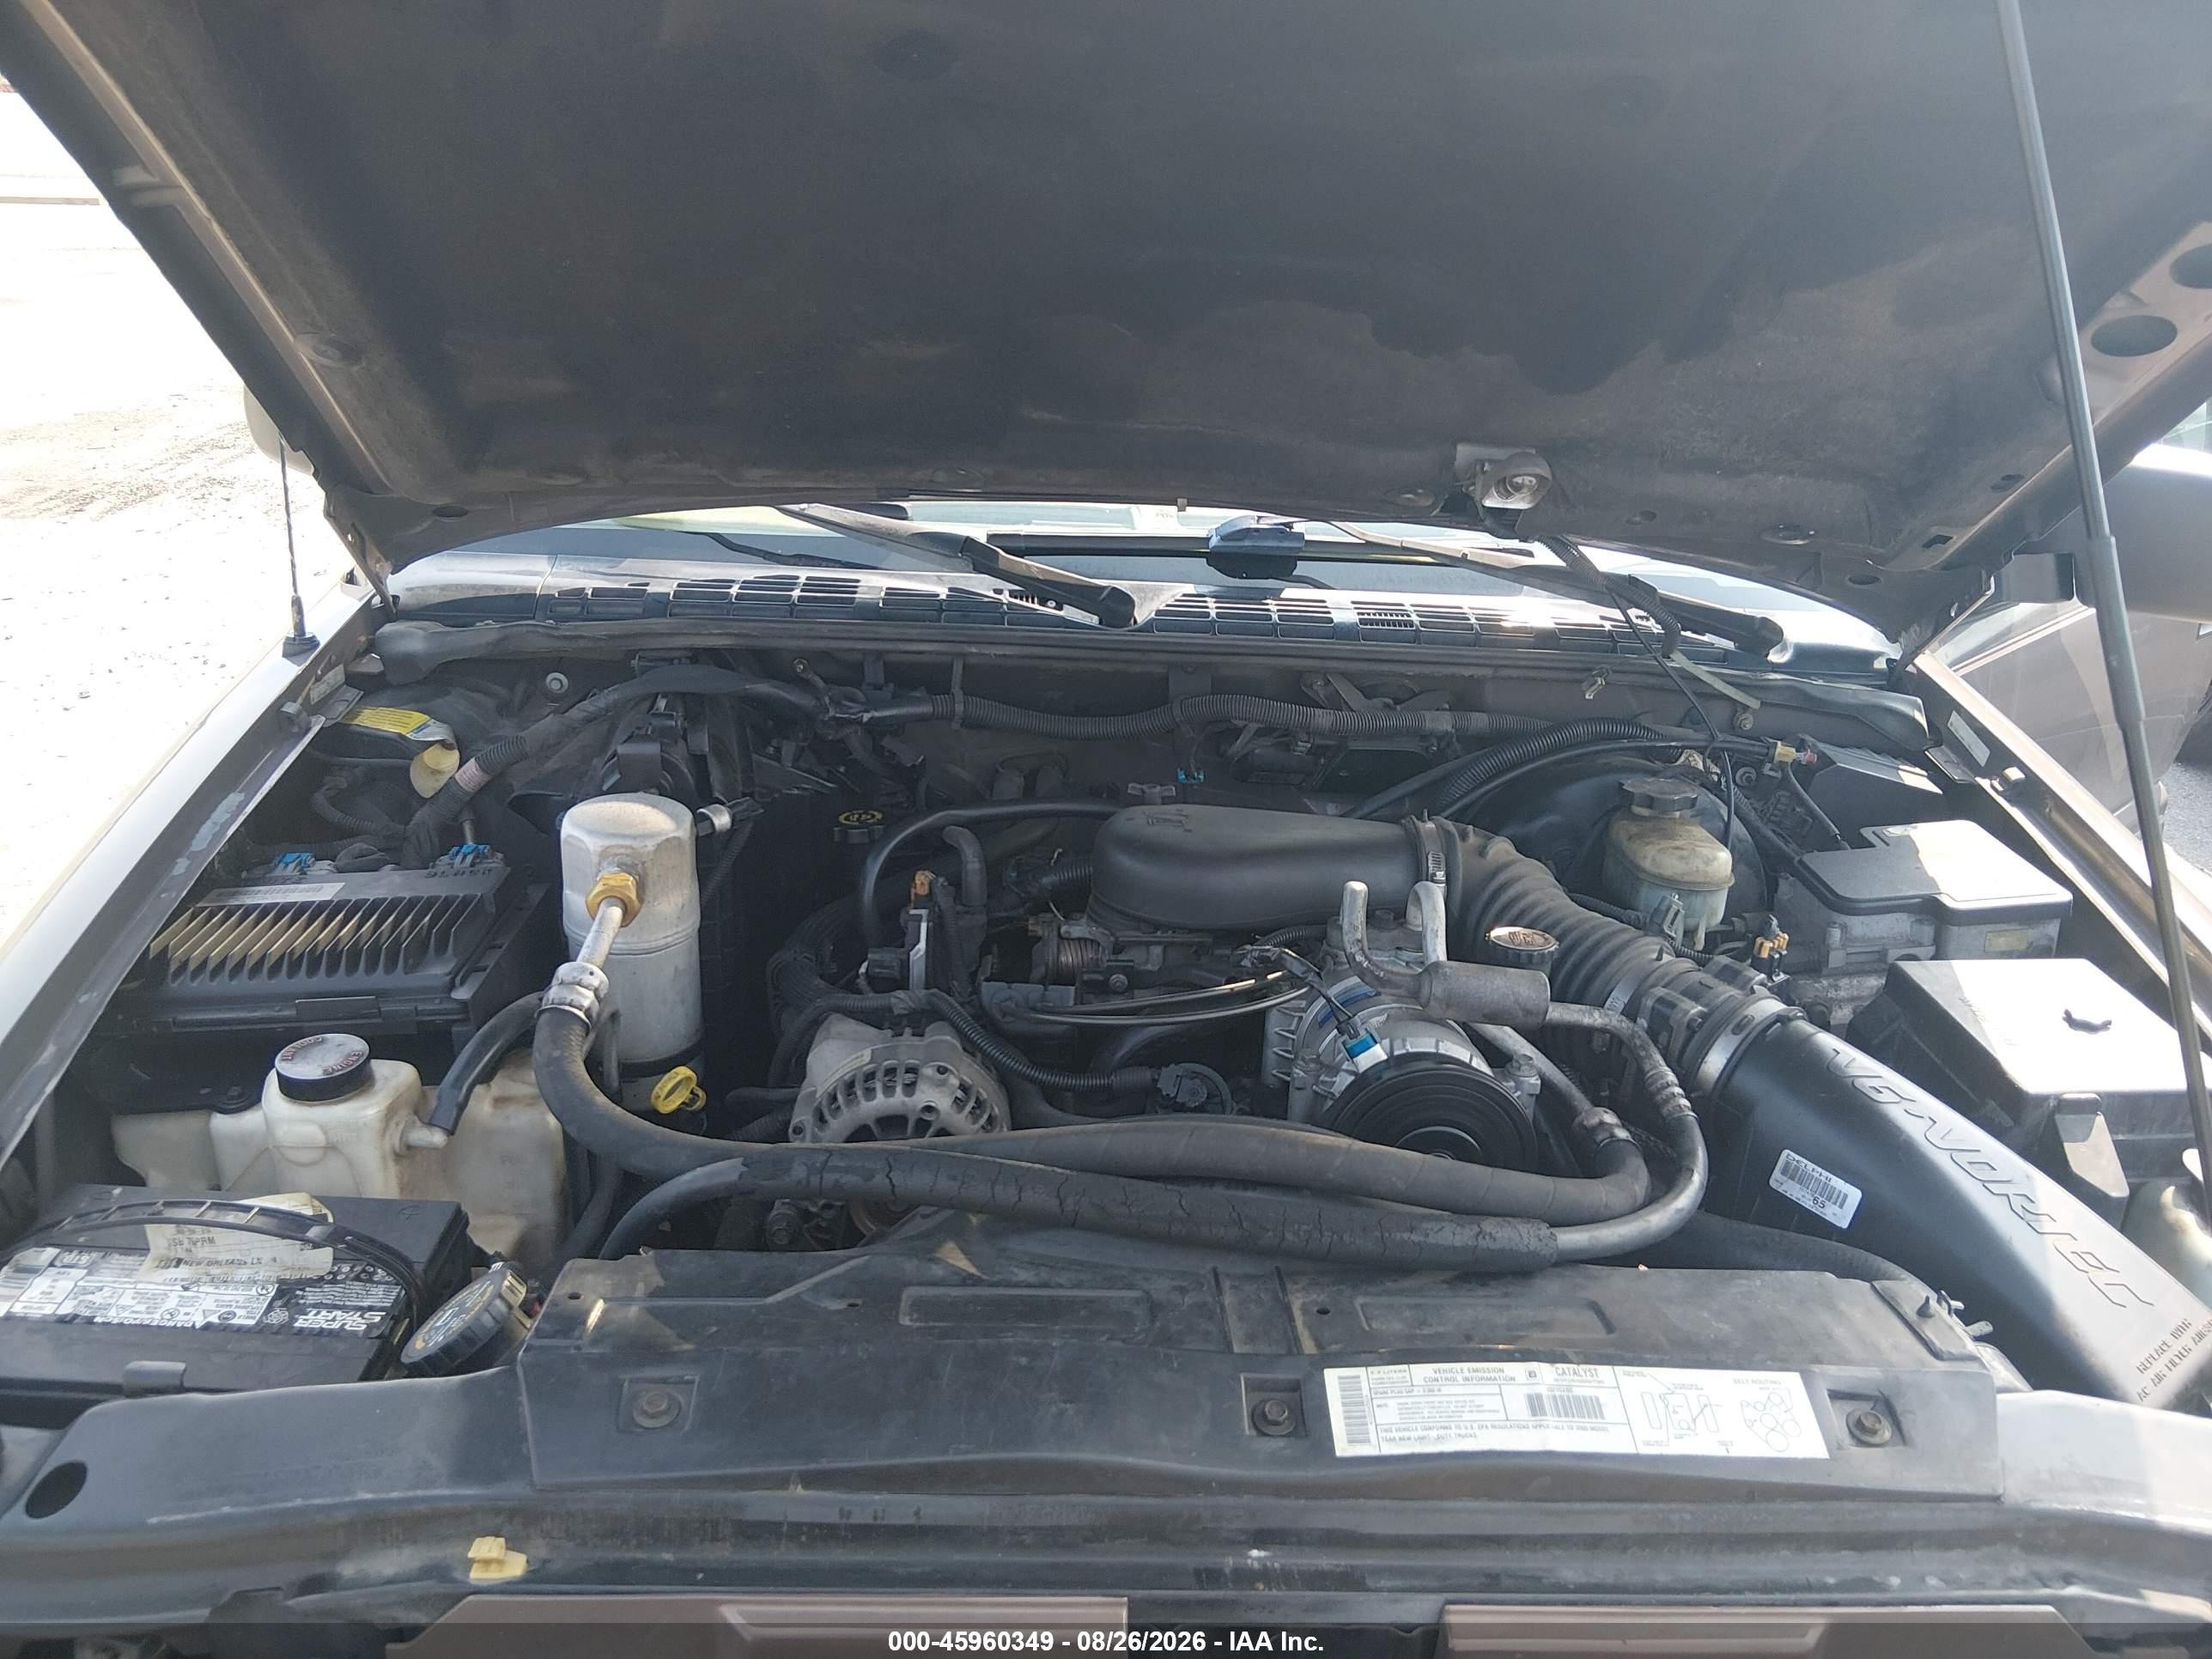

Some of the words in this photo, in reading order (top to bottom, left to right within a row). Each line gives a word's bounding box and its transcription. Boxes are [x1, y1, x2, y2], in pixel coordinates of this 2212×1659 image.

[281, 1036, 323, 1063] COOLANT
[323, 1050, 364, 1073] ENGINE
[1786, 1153, 1832, 1182] DELPHI
[1813, 1196, 1826, 1209] 65
[294, 1318, 368, 1330] SUPER
[299, 1310, 386, 1323] START
[2136, 1340, 2172, 1374] REPLACE
[1554, 1366, 1600, 1378] CATALYST
[2136, 1386, 2151, 1402] AC
[2150, 1370, 2167, 1387] AIR
[2164, 1344, 2192, 1371] FILTER
